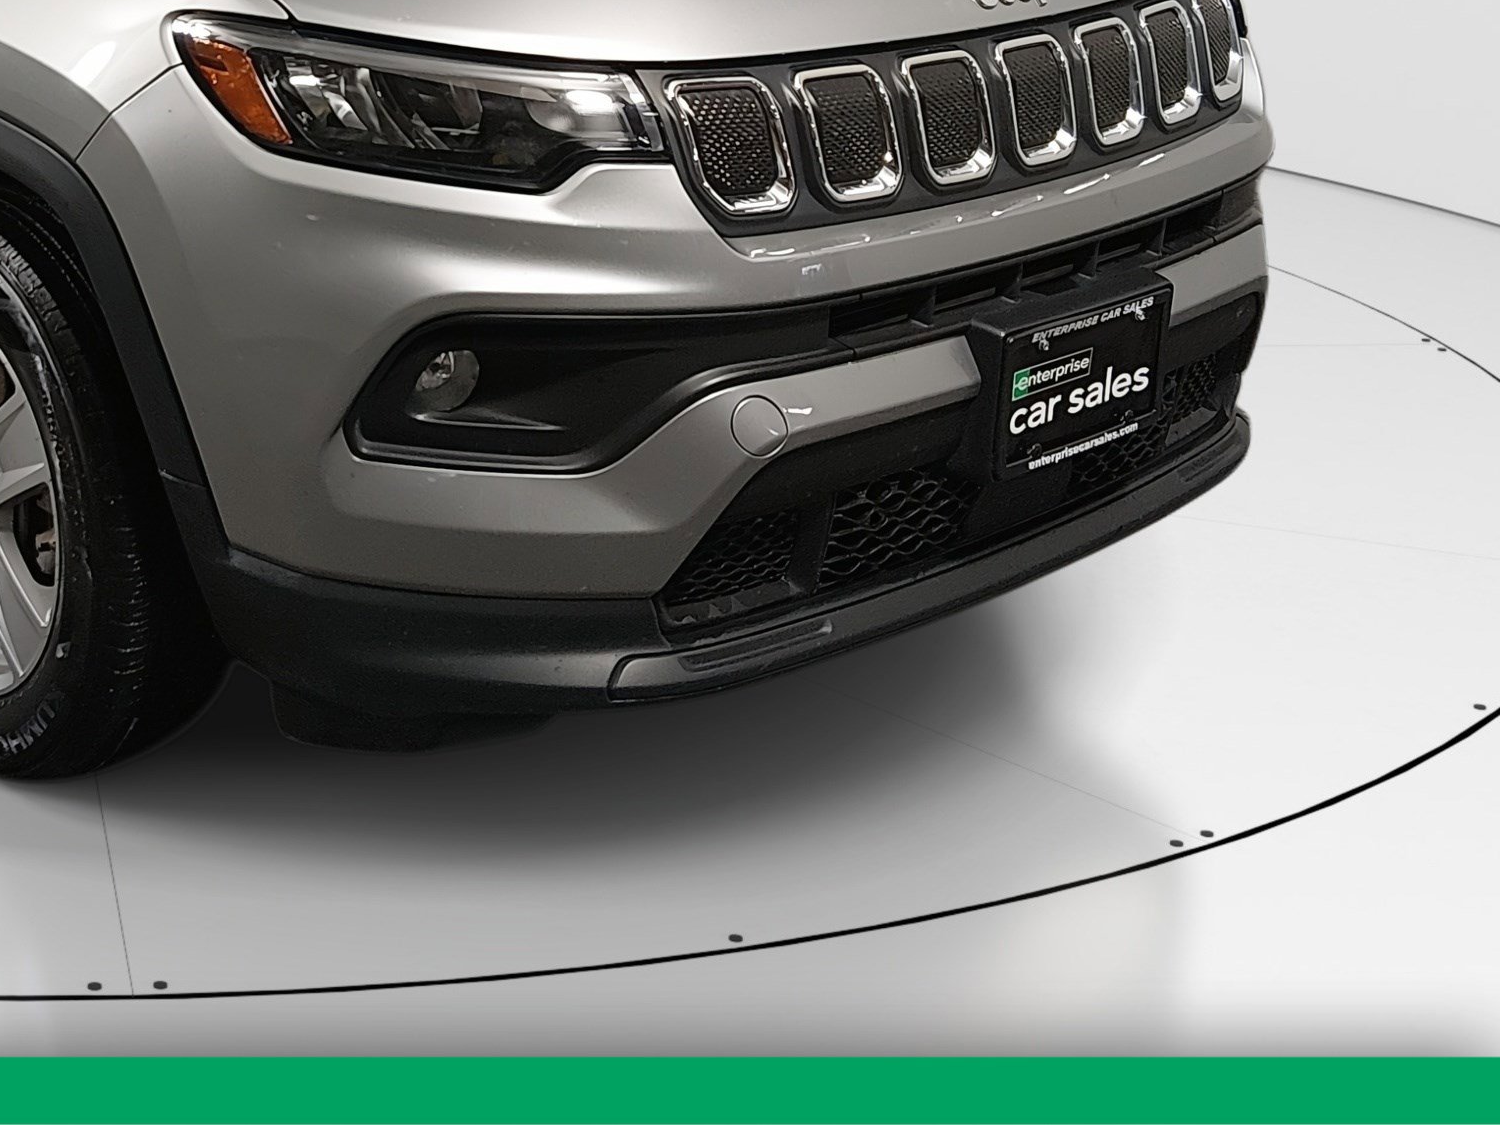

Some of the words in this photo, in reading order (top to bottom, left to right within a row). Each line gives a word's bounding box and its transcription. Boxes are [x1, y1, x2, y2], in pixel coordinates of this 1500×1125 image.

[1031, 315, 1099, 343] ENTERPRISE
[1100, 308, 1121, 323] CAR
[1122, 296, 1154, 315] SALES
[1014, 356, 1090, 391] enterprise
[1009, 393, 1062, 435] car
[1067, 366, 1150, 414] sales
[1028, 422, 1138, 470] enterprisecarsales.com
